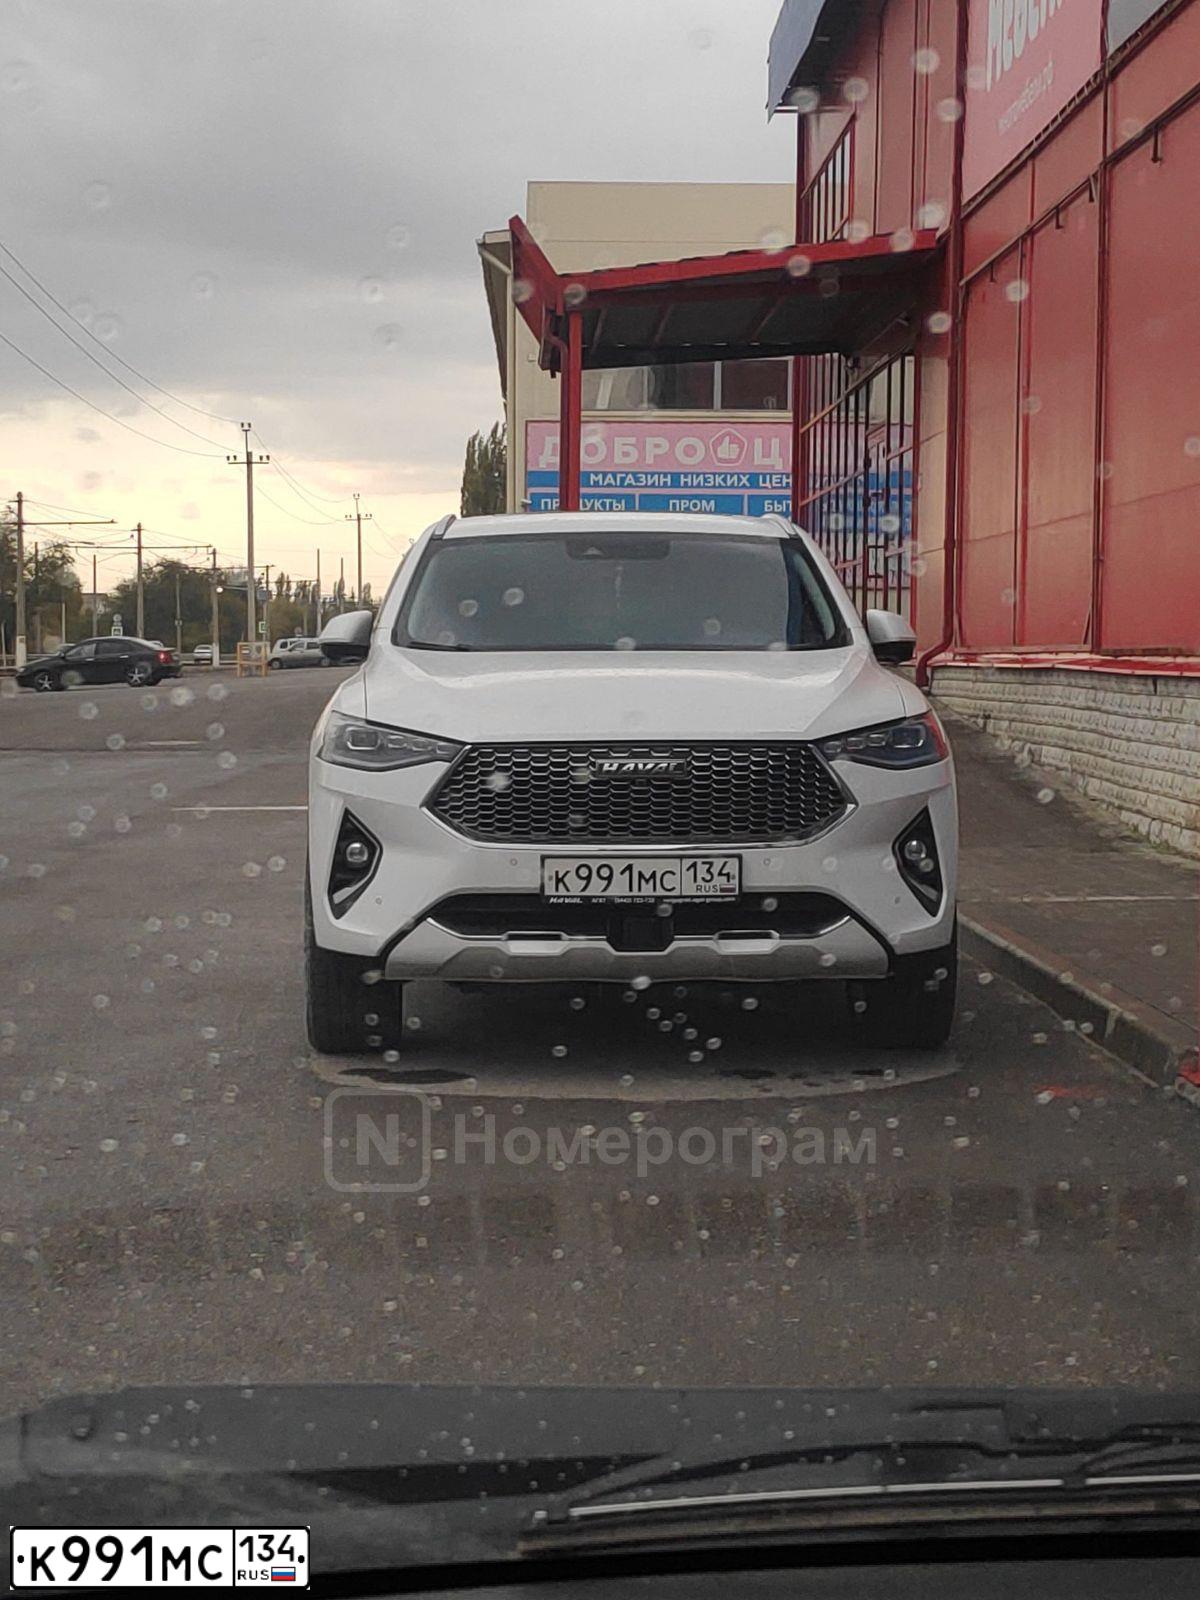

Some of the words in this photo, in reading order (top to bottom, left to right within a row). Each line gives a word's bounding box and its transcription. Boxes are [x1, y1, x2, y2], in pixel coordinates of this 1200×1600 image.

[589, 473, 672, 486] МАГАЗИН
[680, 474, 750, 487] НИЗКИХ
[669, 500, 715, 512] ПРОМ
[686, 861, 731, 883] 134
[696, 884, 719, 893] RUS
